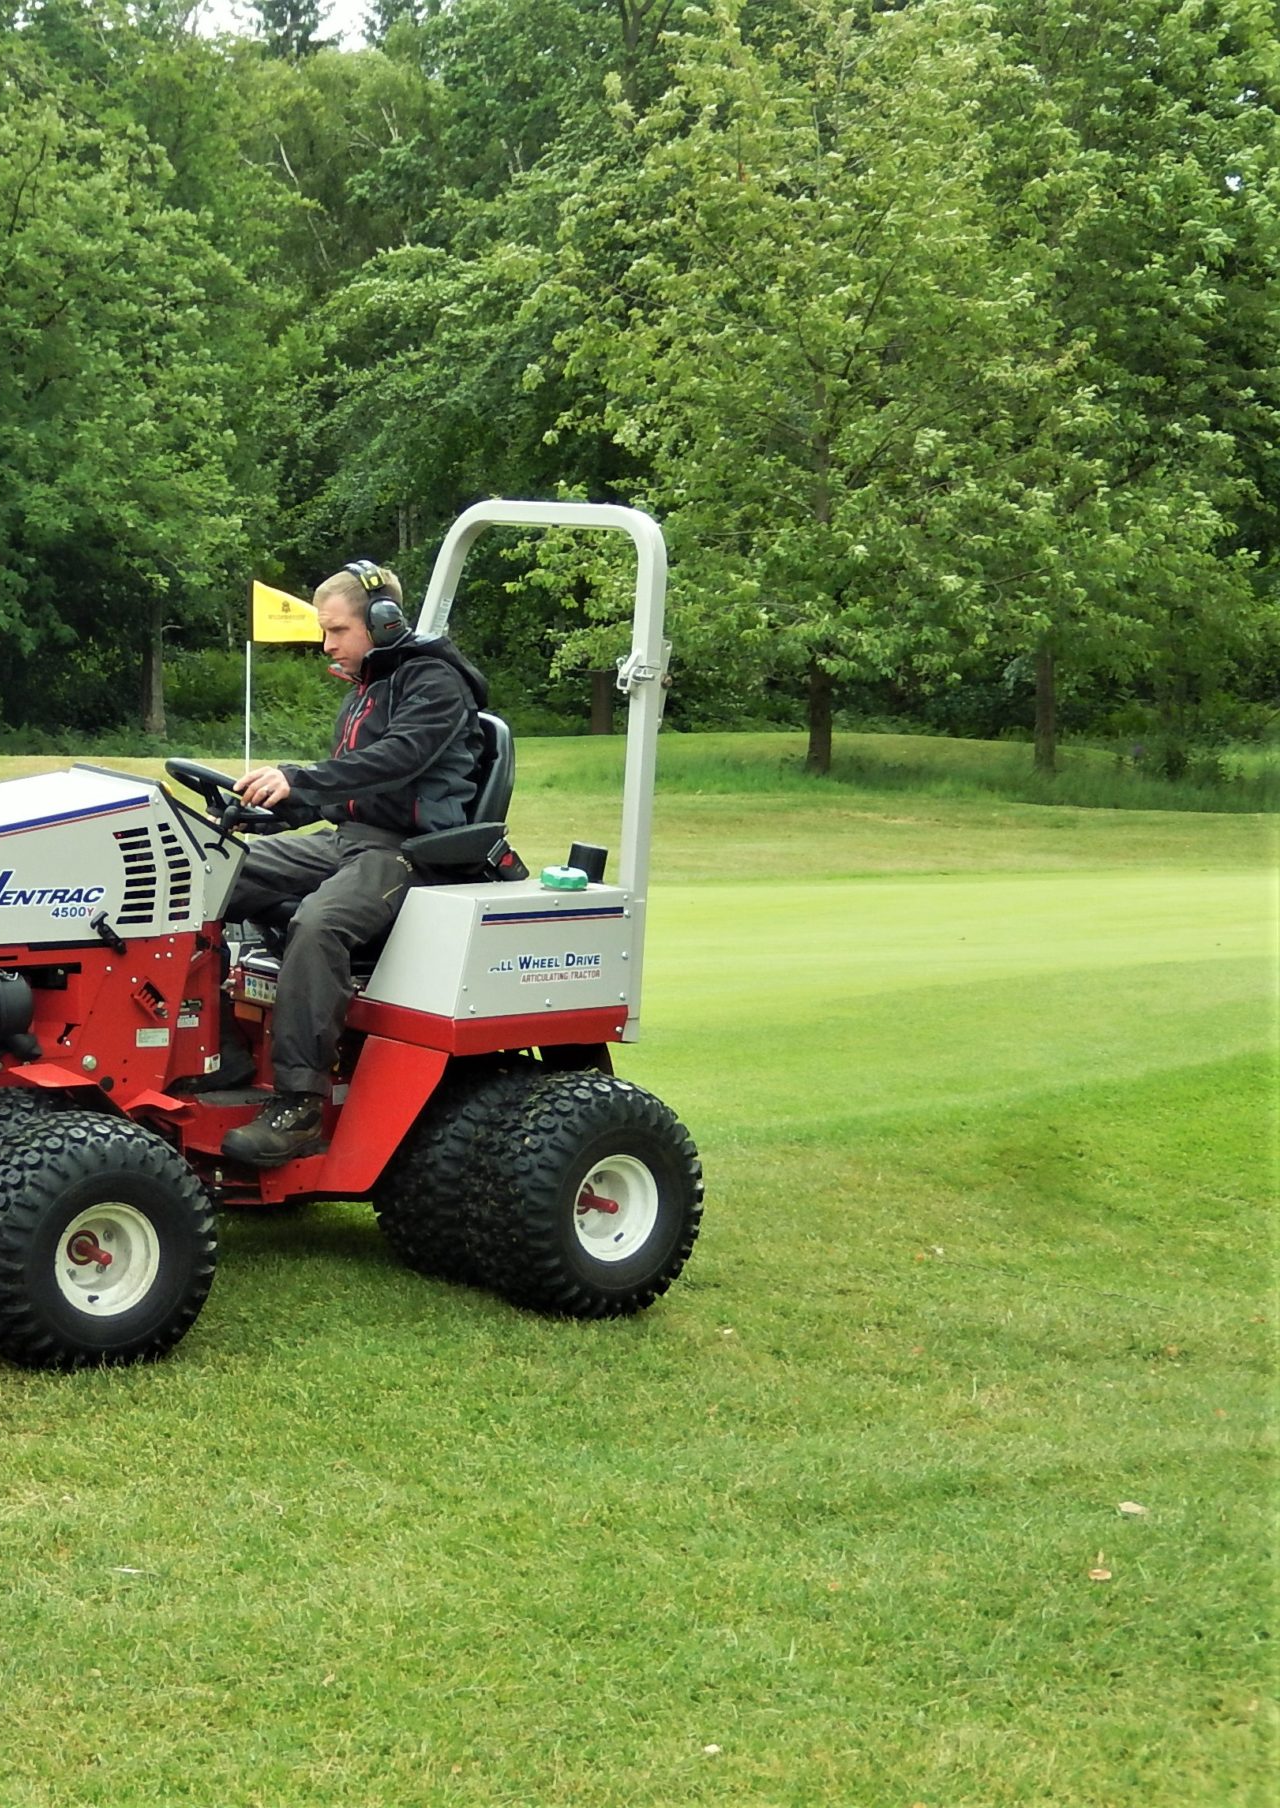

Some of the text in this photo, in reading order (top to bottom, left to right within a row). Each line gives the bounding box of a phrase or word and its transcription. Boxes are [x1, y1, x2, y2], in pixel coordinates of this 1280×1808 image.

[51, 906, 94, 918] 4500Y
[518, 956, 560, 970] WHEEL
[565, 953, 600, 967] DRIVE
[521, 969, 600, 983] ARTICULATING TRACTOR
